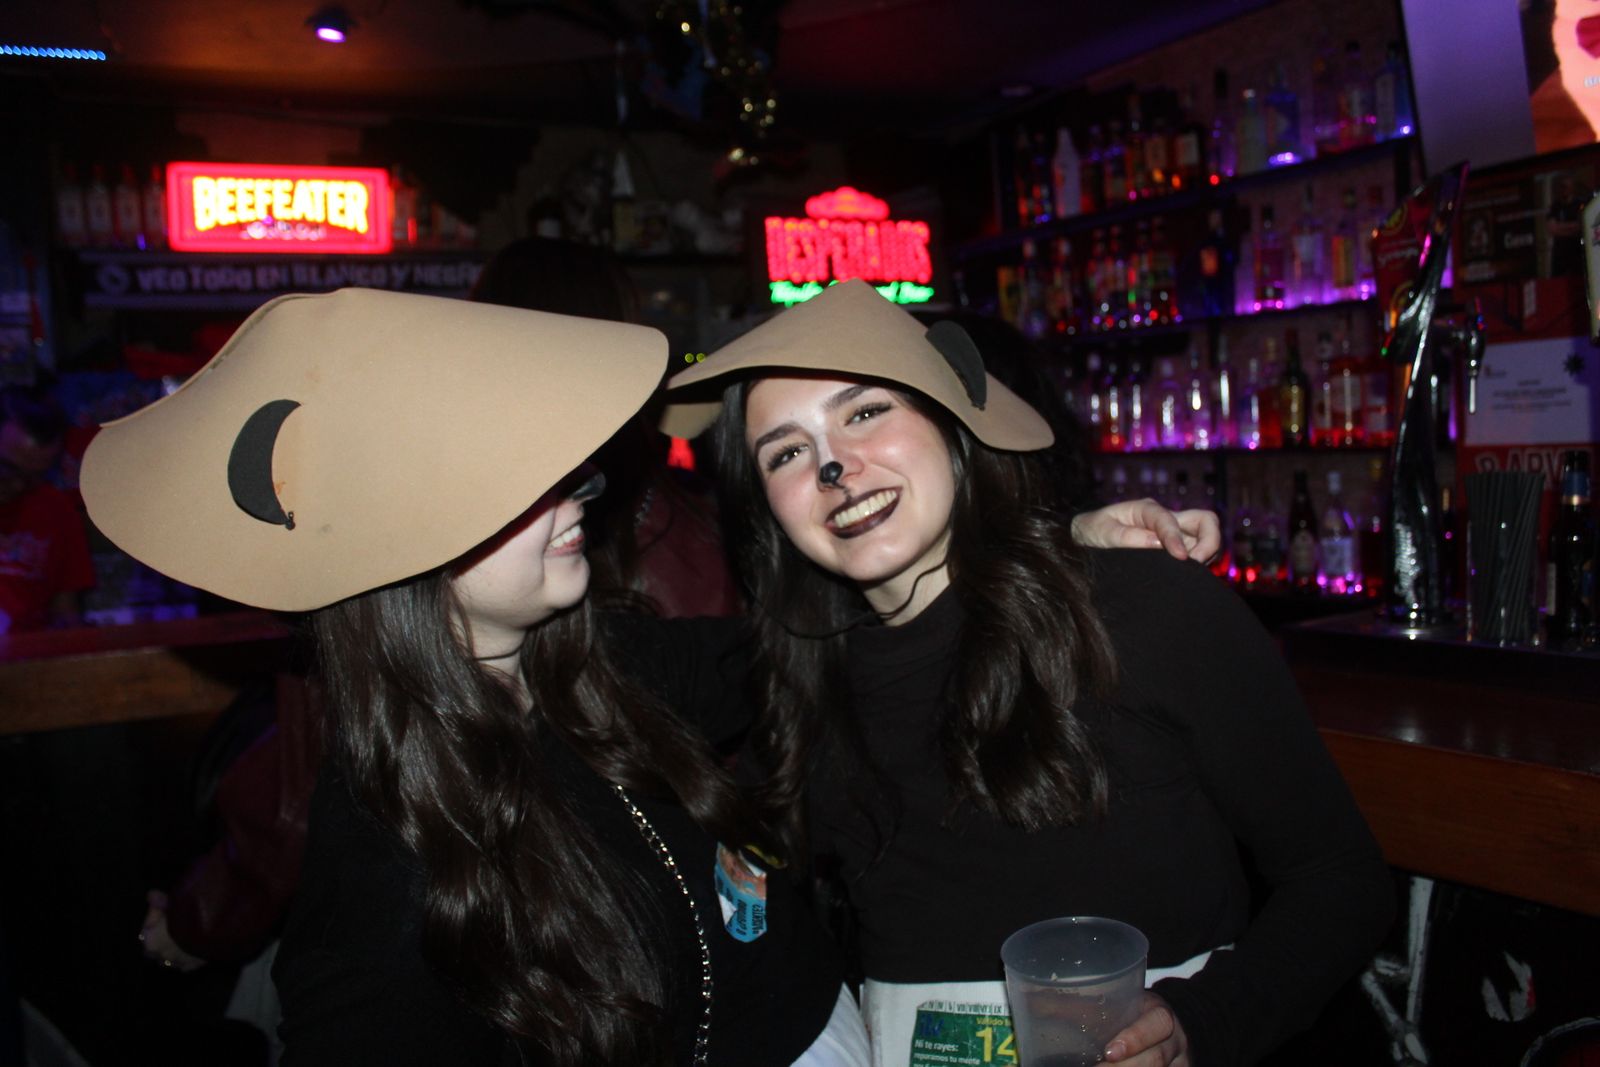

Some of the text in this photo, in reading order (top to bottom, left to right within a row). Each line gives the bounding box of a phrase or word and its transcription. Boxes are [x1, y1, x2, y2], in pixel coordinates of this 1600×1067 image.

[193, 176, 369, 234] BEEFEATER
[925, 1041, 933, 1050] te
[933, 1042, 959, 1053] rayes:
[976, 1027, 1018, 1064] 14
